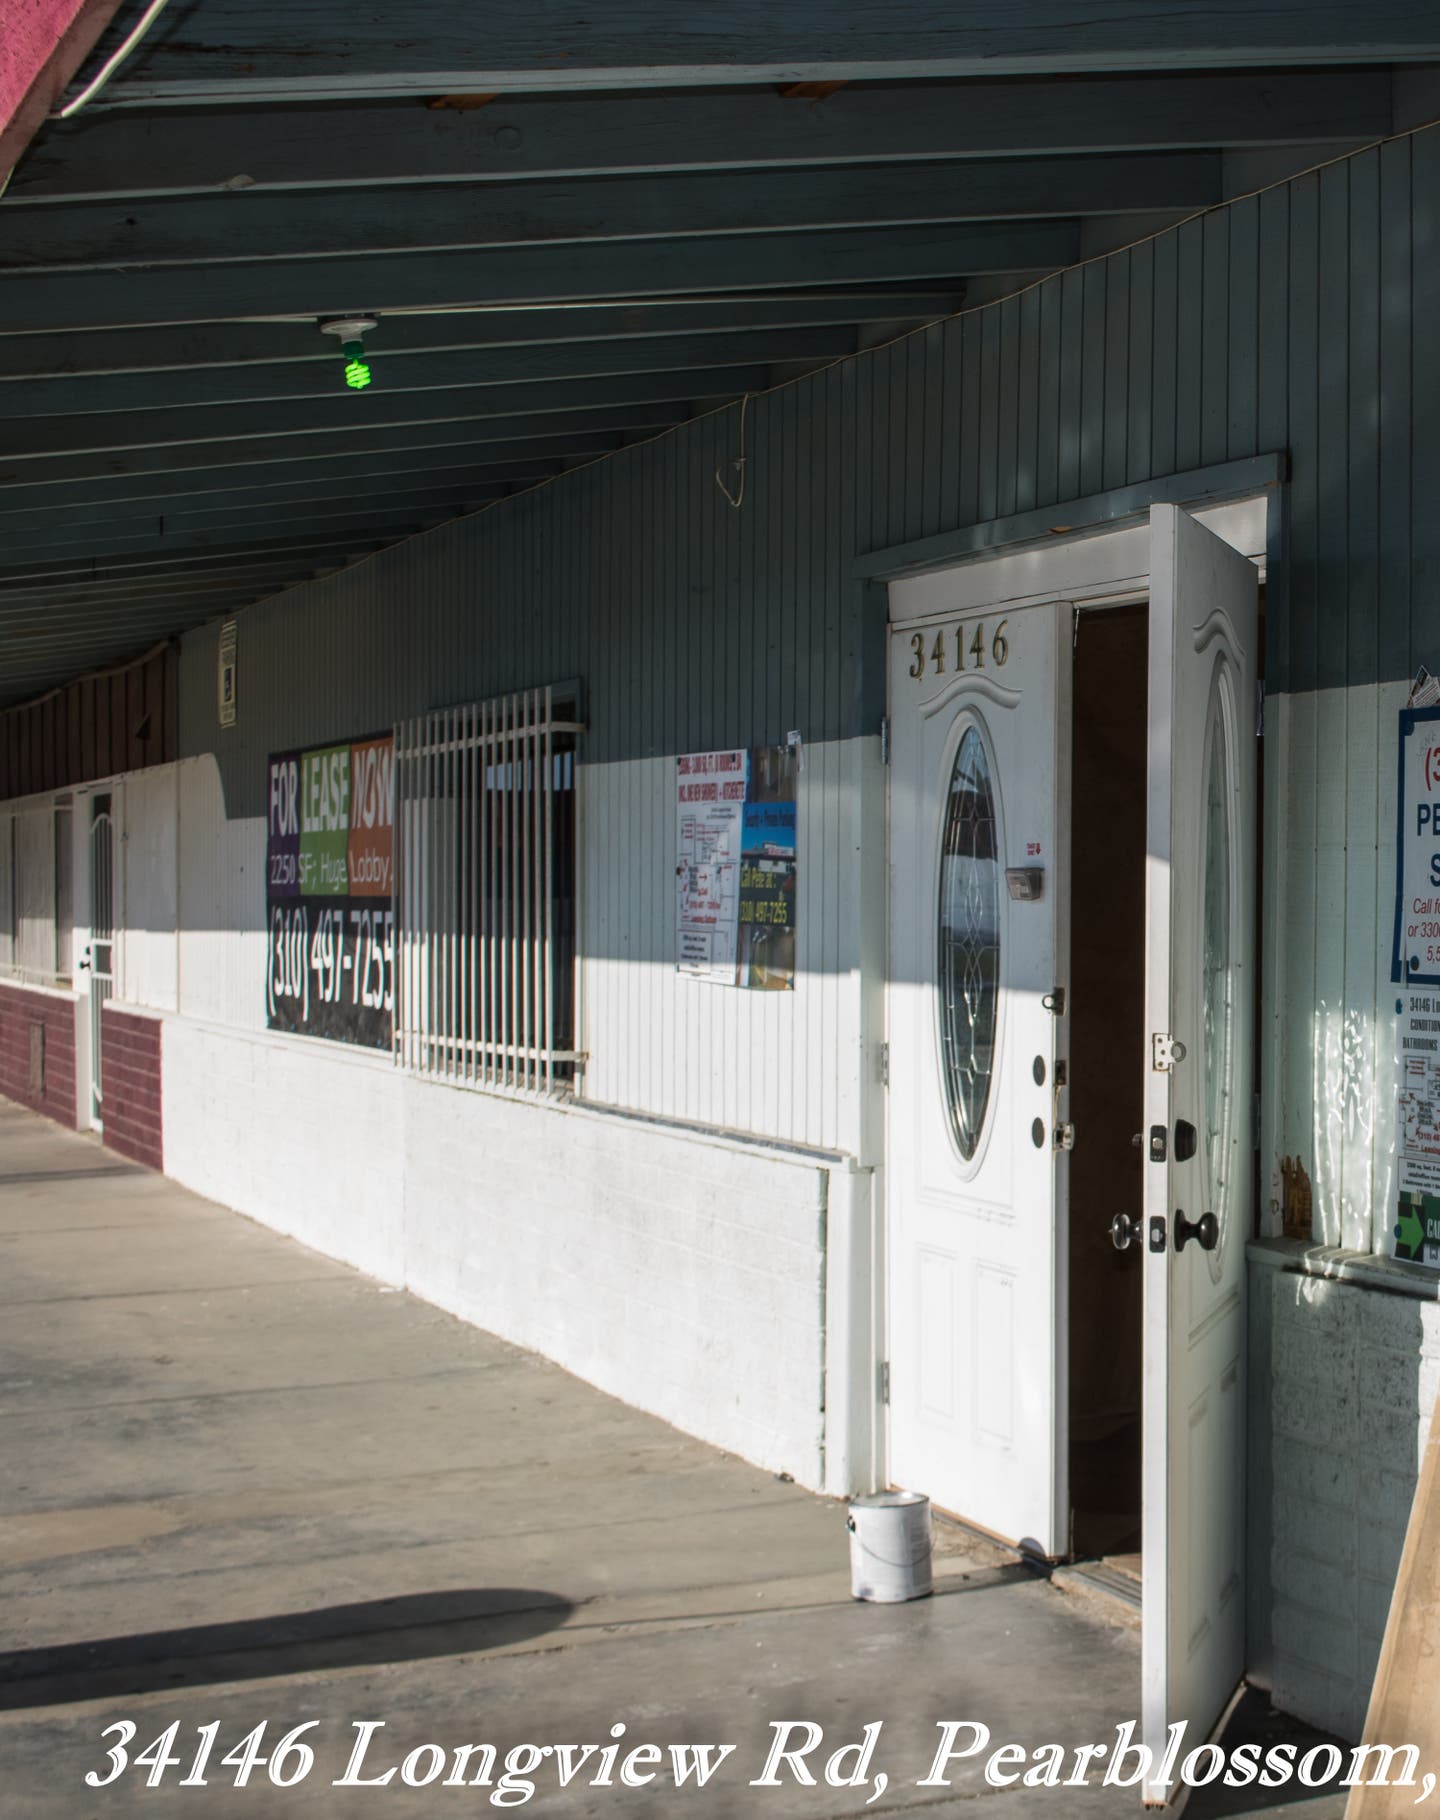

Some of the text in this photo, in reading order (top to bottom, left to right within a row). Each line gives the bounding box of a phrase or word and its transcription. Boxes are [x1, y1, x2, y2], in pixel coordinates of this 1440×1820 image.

[909, 619, 1009, 681] 34146
[271, 746, 393, 837] FOR LEASE NOW
[271, 853, 297, 885] 2250
[321, 852, 348, 892] Huge
[1413, 898, 1431, 915] Call
[1407, 923, 1419, 938] or
[267, 904, 309, 1023] (310)
[1410, 996, 1431, 1013] 34146
